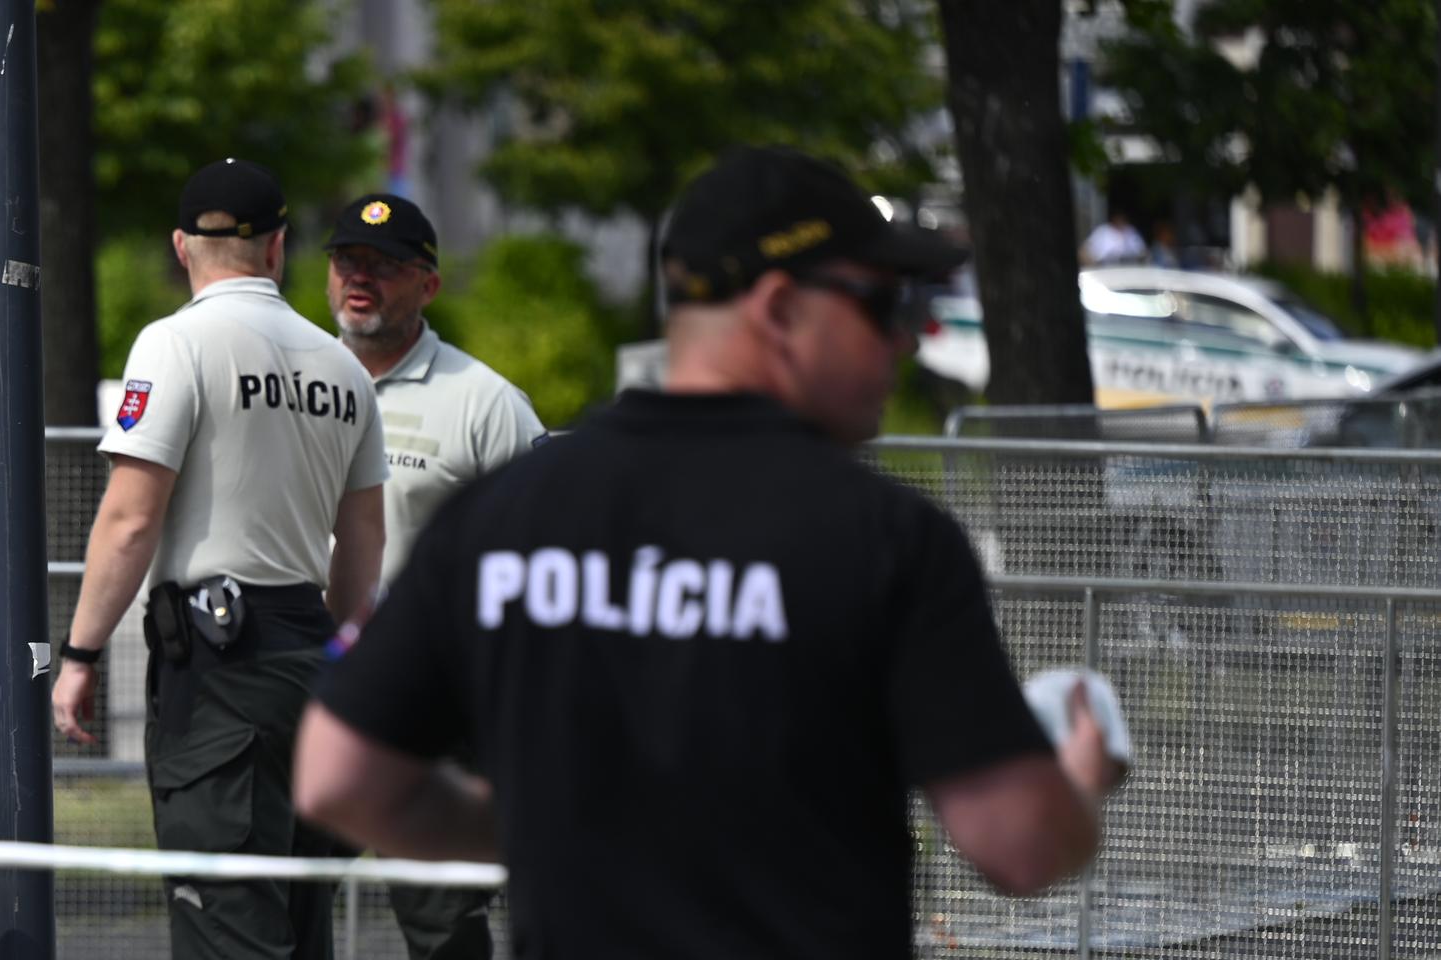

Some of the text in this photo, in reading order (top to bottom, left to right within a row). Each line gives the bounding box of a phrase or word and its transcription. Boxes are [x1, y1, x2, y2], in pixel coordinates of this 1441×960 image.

[239, 371, 357, 426] POLÍCIA
[384, 452, 427, 470] LÍCIA
[478, 546, 787, 641] POLÍCIA
